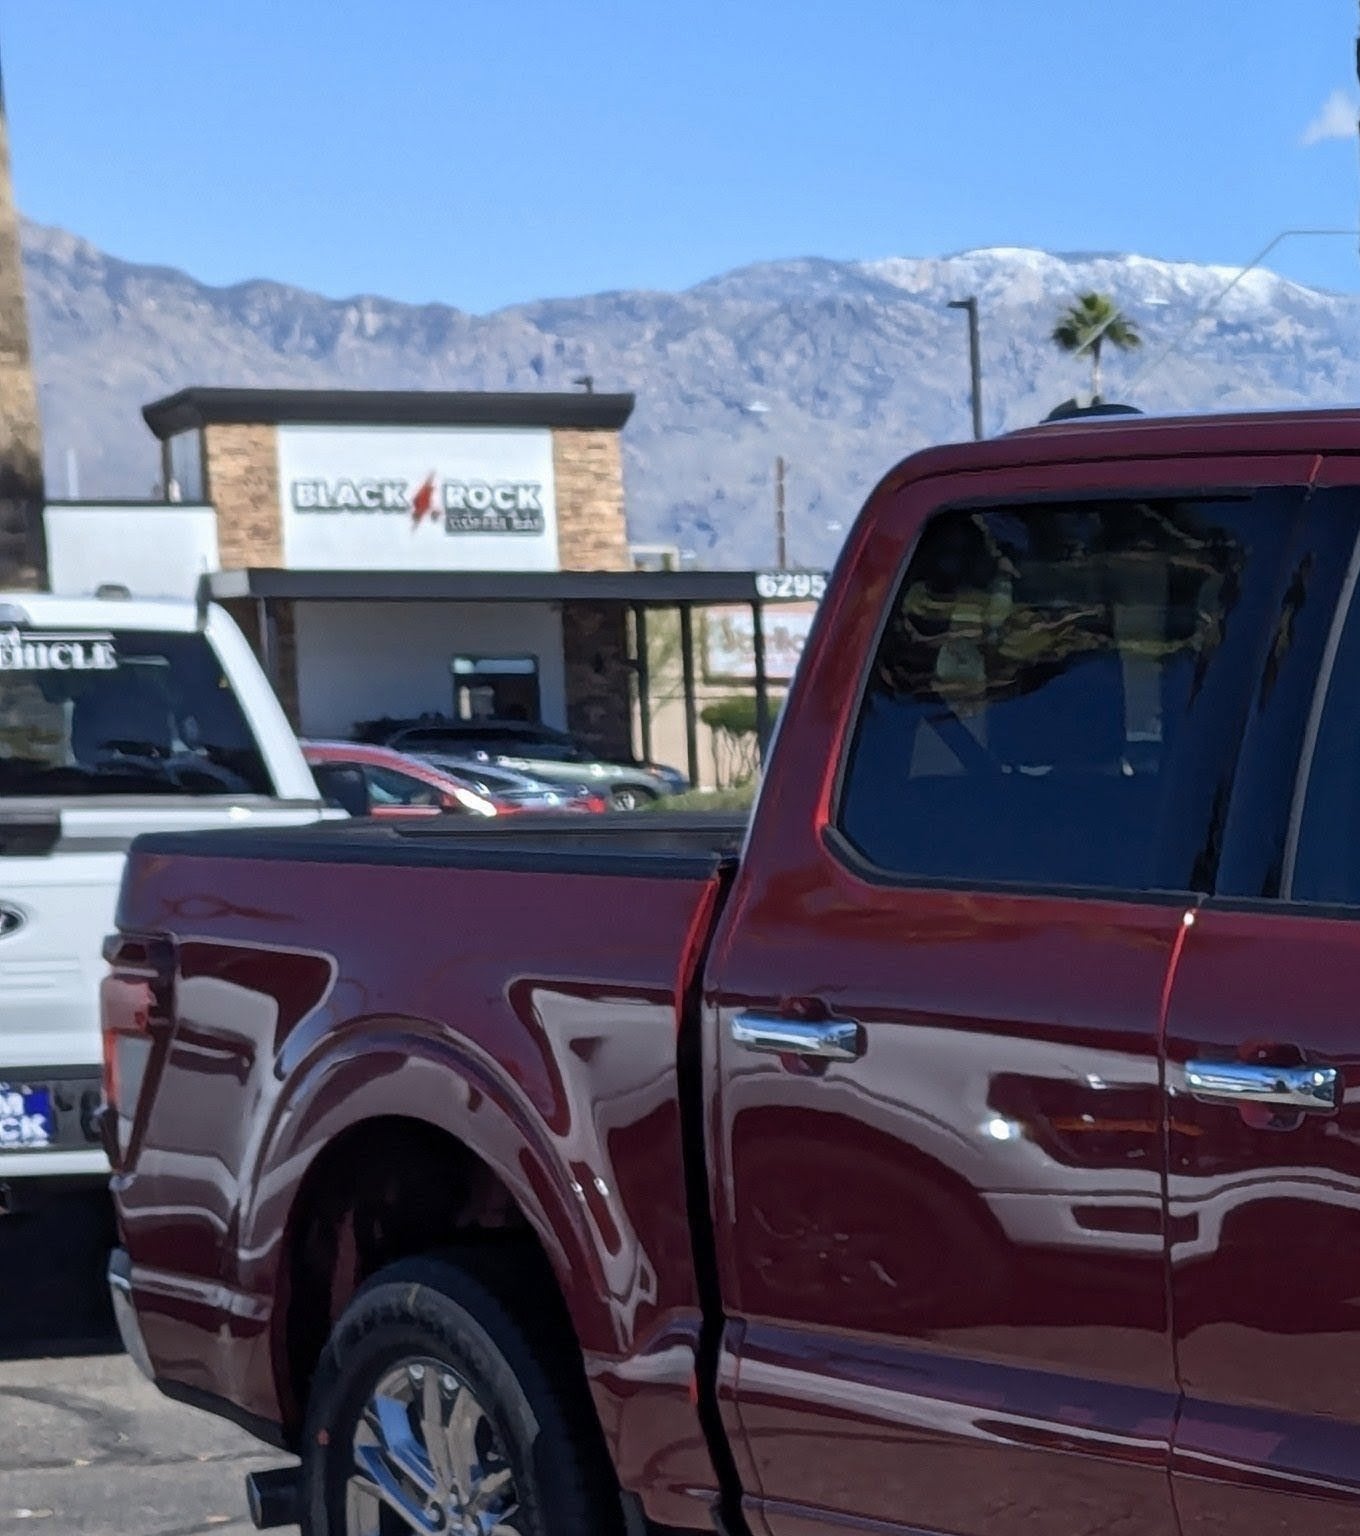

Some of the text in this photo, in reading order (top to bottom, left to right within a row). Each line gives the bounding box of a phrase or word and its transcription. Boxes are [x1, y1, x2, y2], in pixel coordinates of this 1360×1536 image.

[293, 480, 541, 511] BLACK ROCK
[755, 573, 828, 599] 6295
